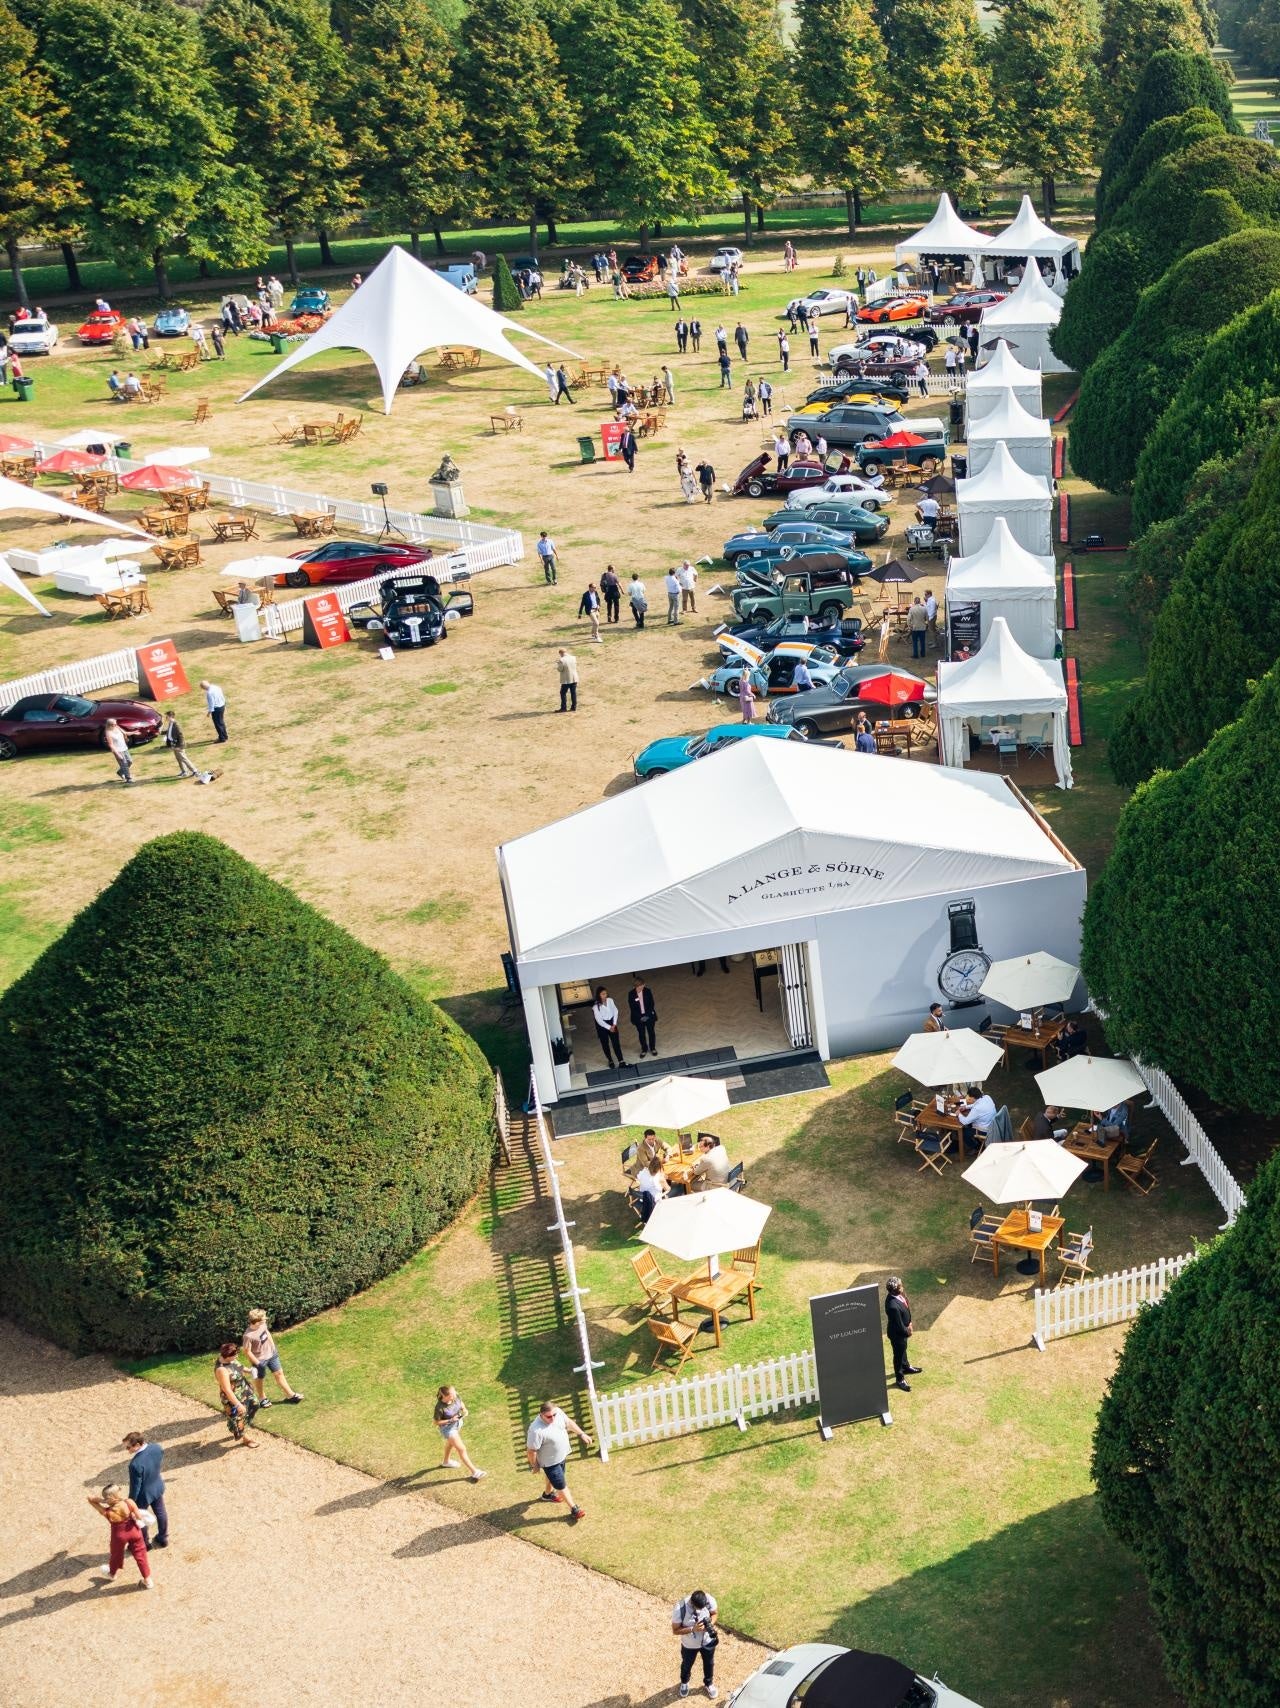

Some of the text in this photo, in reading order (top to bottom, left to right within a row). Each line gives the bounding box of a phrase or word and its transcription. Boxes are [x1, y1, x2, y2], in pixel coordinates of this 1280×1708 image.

[808, 864, 821, 874] &
[825, 861, 885, 881] SÖHNE
[761, 885, 825, 900] GLASHÜTTE
[840, 1327, 867, 1337] LOUNGE
